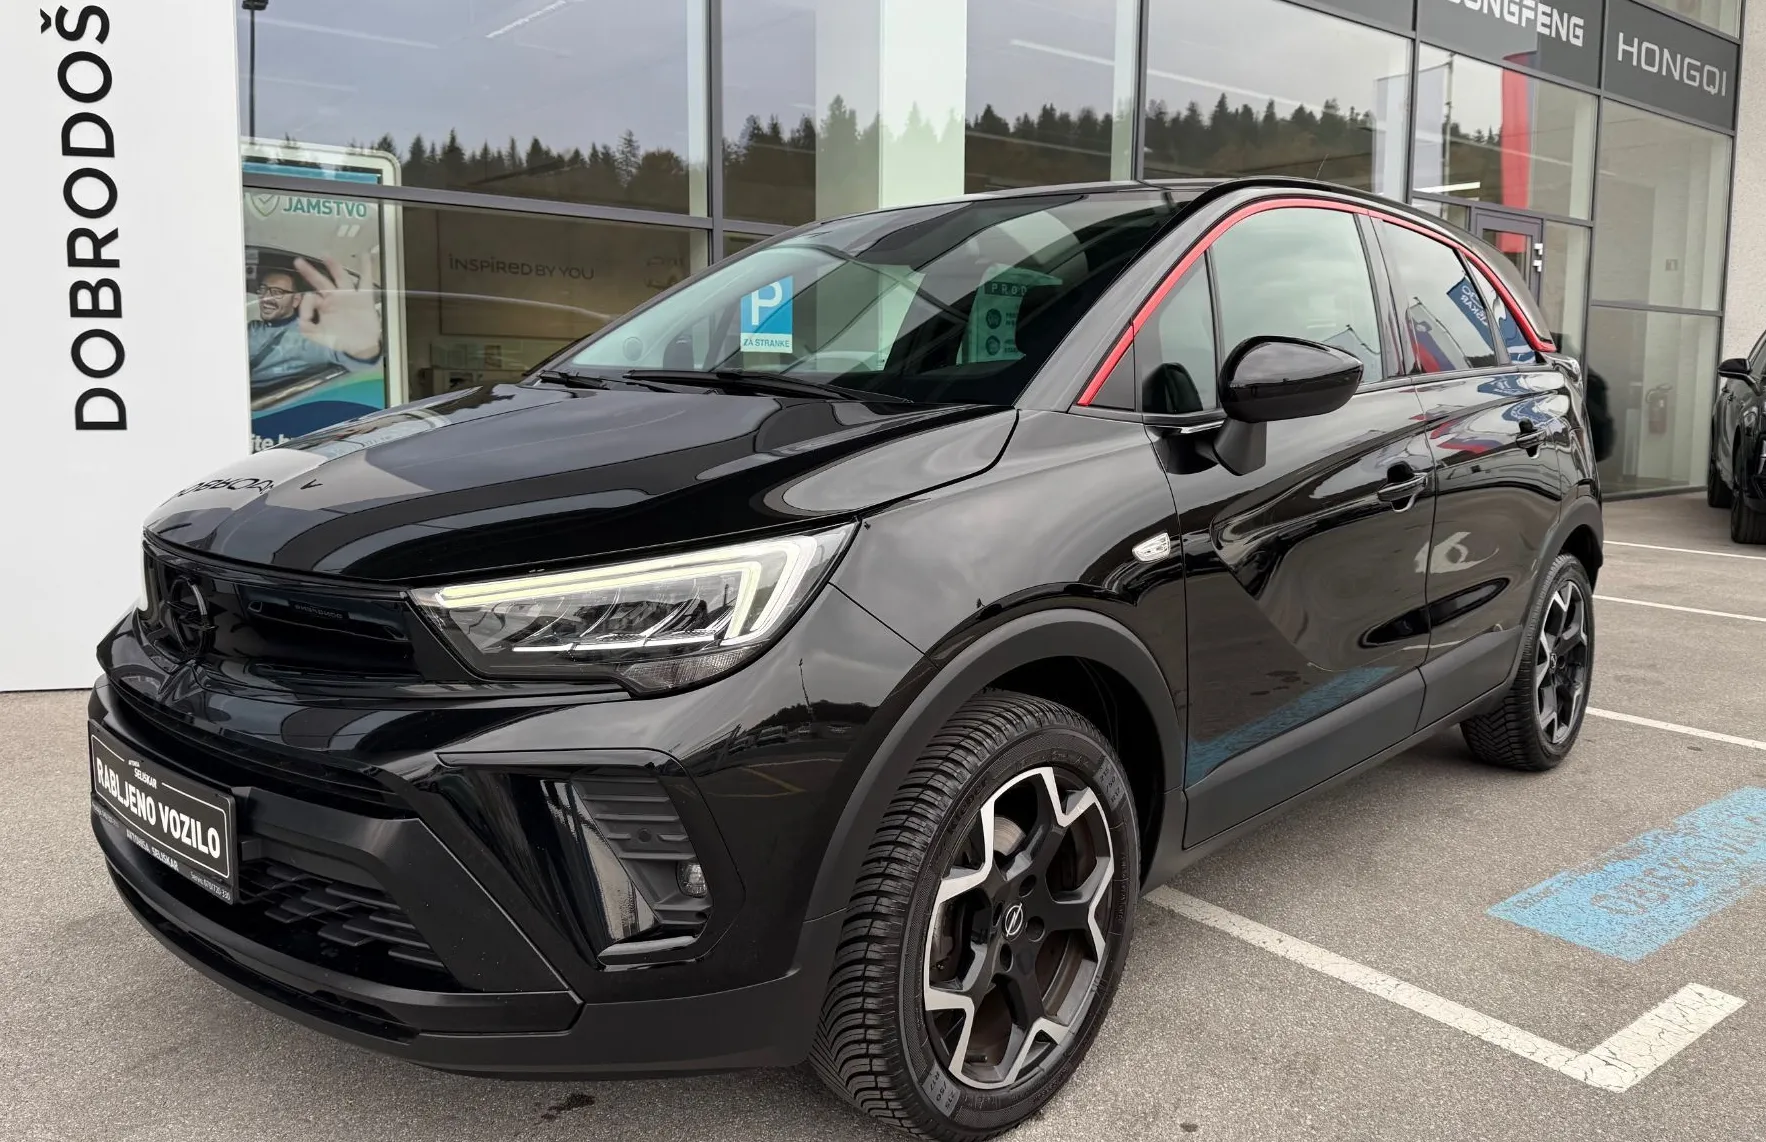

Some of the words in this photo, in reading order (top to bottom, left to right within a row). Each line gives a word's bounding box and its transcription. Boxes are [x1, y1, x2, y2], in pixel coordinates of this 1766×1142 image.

[1452, 0, 1585, 47] NGFENG
[1617, 31, 1727, 97] HONGQI
[39, 4, 128, 431] DOBRODOŠ
[283, 196, 368, 218] JAMSTVO
[535, 264, 556, 277] BY
[559, 266, 595, 281] YOU
[751, 281, 783, 326] P
[743, 338, 754, 347] ZA
[755, 338, 790, 348] STRANKE
[96, 756, 157, 826] RABLJENO
[158, 801, 221, 859] VOZILO
